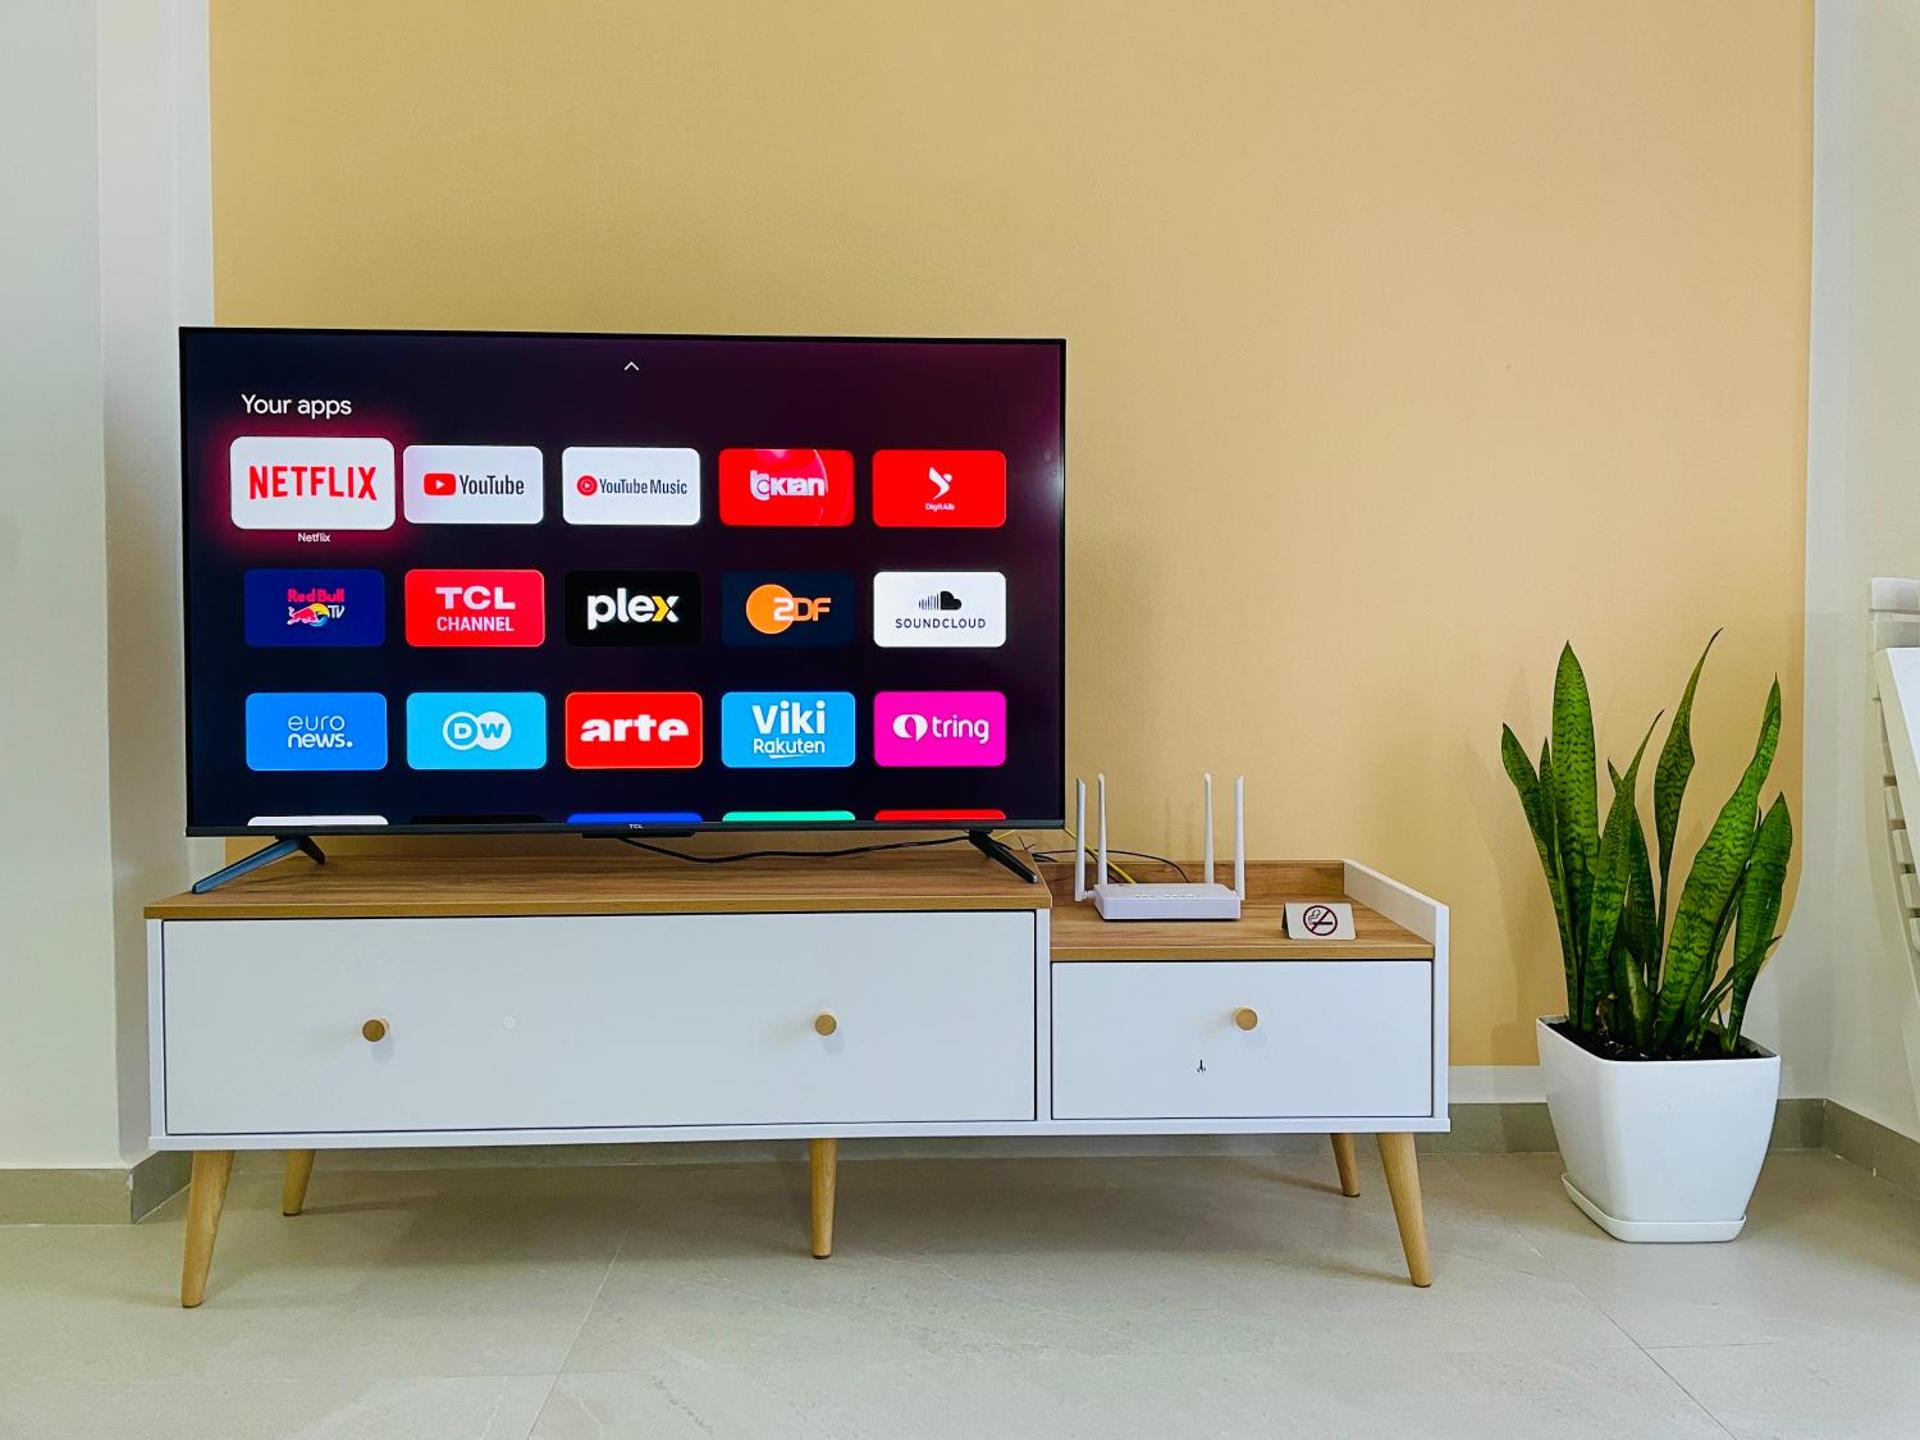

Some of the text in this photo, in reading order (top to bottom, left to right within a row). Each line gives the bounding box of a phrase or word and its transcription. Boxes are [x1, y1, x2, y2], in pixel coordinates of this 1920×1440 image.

[241, 394, 352, 419] Your apps
[249, 466, 377, 501] NETFLIX
[460, 475, 524, 495] YouTube
[599, 478, 688, 495] YouTube Music
[298, 532, 330, 542] Netflix
[287, 588, 345, 603] Red Bull
[435, 586, 515, 610] TCL
[328, 605, 345, 619] TV
[587, 588, 680, 631] plex
[773, 596, 832, 622] ZDF
[437, 616, 514, 632] CHANNEL
[895, 617, 986, 630] SOUNDCLOUD
[288, 715, 345, 731] euro
[752, 700, 826, 734] Viki
[454, 722, 504, 740] DW
[581, 715, 689, 742] arte
[931, 714, 989, 744] tring
[288, 732, 353, 748] news.
[753, 738, 825, 754] Rakuten
